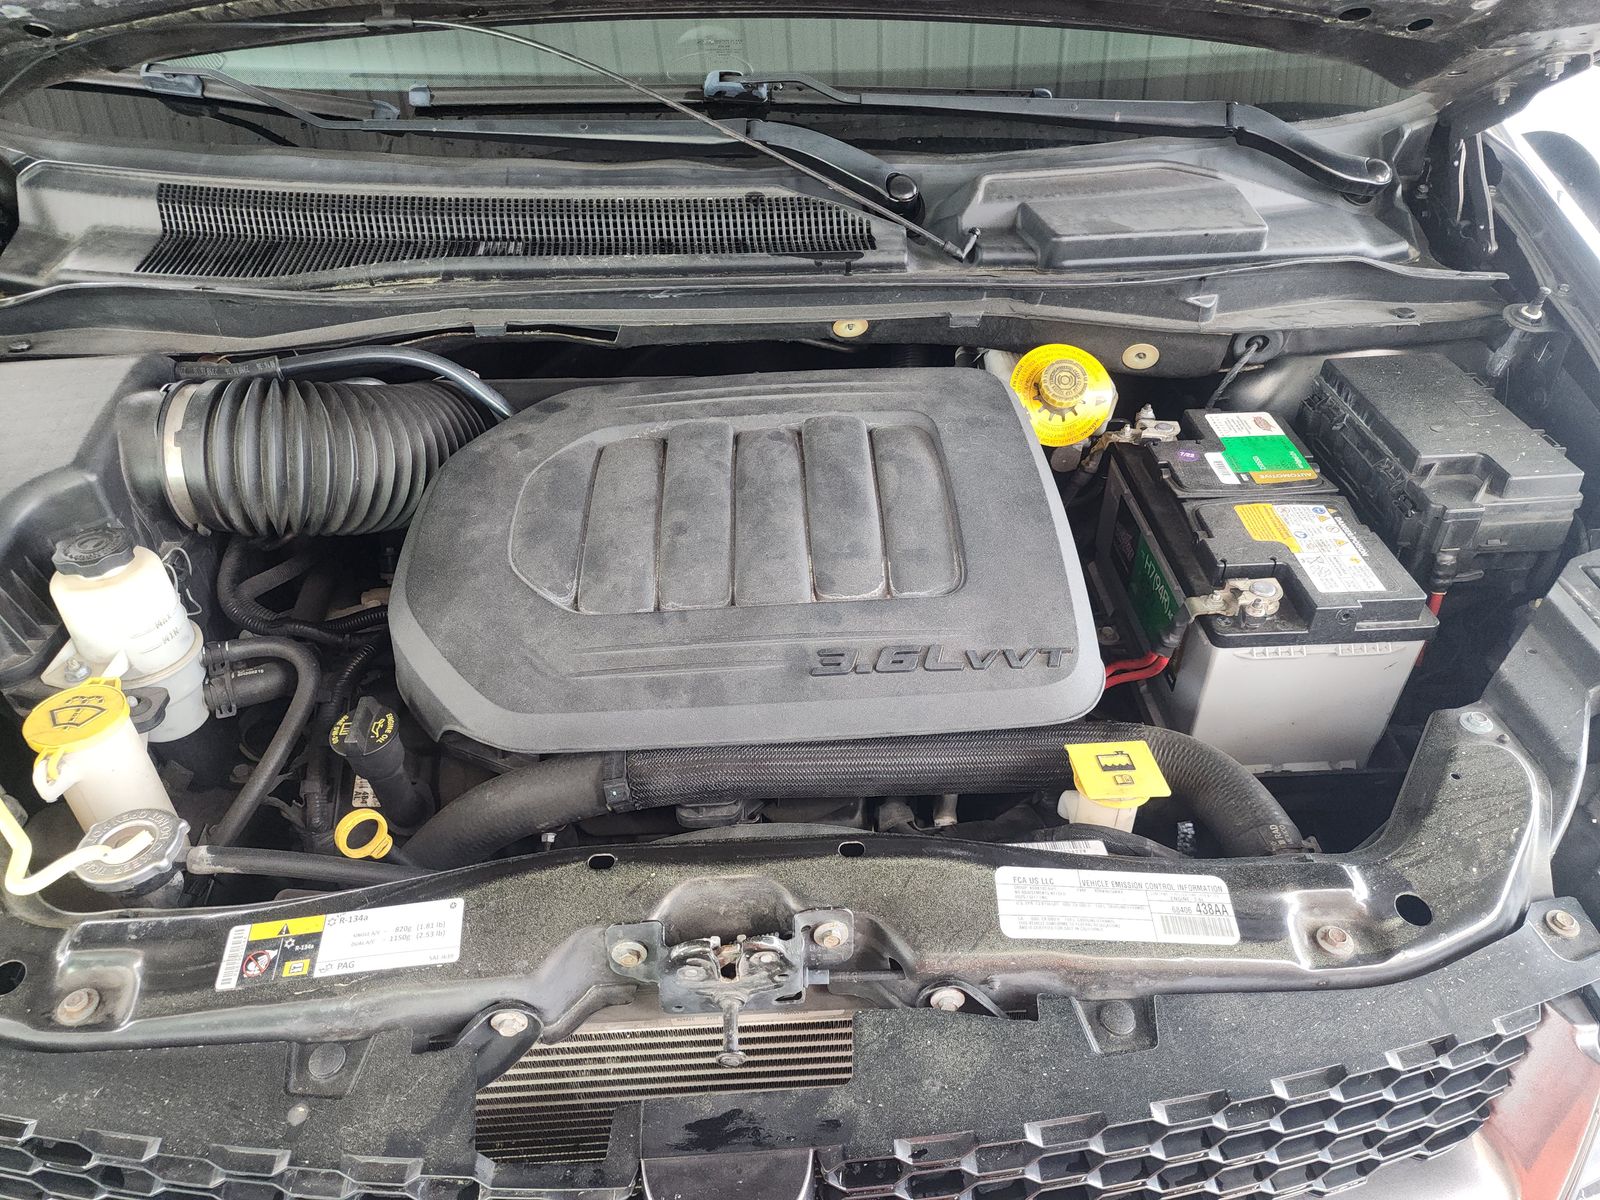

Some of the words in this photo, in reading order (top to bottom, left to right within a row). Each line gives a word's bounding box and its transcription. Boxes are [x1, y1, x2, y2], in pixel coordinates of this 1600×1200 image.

[384, 712, 395, 734] ENGINE
[376, 734, 389, 744] OIL
[1269, 824, 1284, 839] RAD
[1013, 876, 1028, 885] FCA
[1029, 877, 1040, 885] US
[1041, 877, 1055, 886] LLC
[1081, 879, 1109, 889] VEHICLE
[1110, 880, 1143, 890] EMISSION
[1144, 882, 1176, 892] CONTROL
[1177, 883, 1223, 893] INFORMATION
[1195, 903, 1229, 916] 438AA
[339, 913, 369, 925] R-134a
[295, 943, 315, 951] R-134a
[336, 960, 355, 970] PAG
